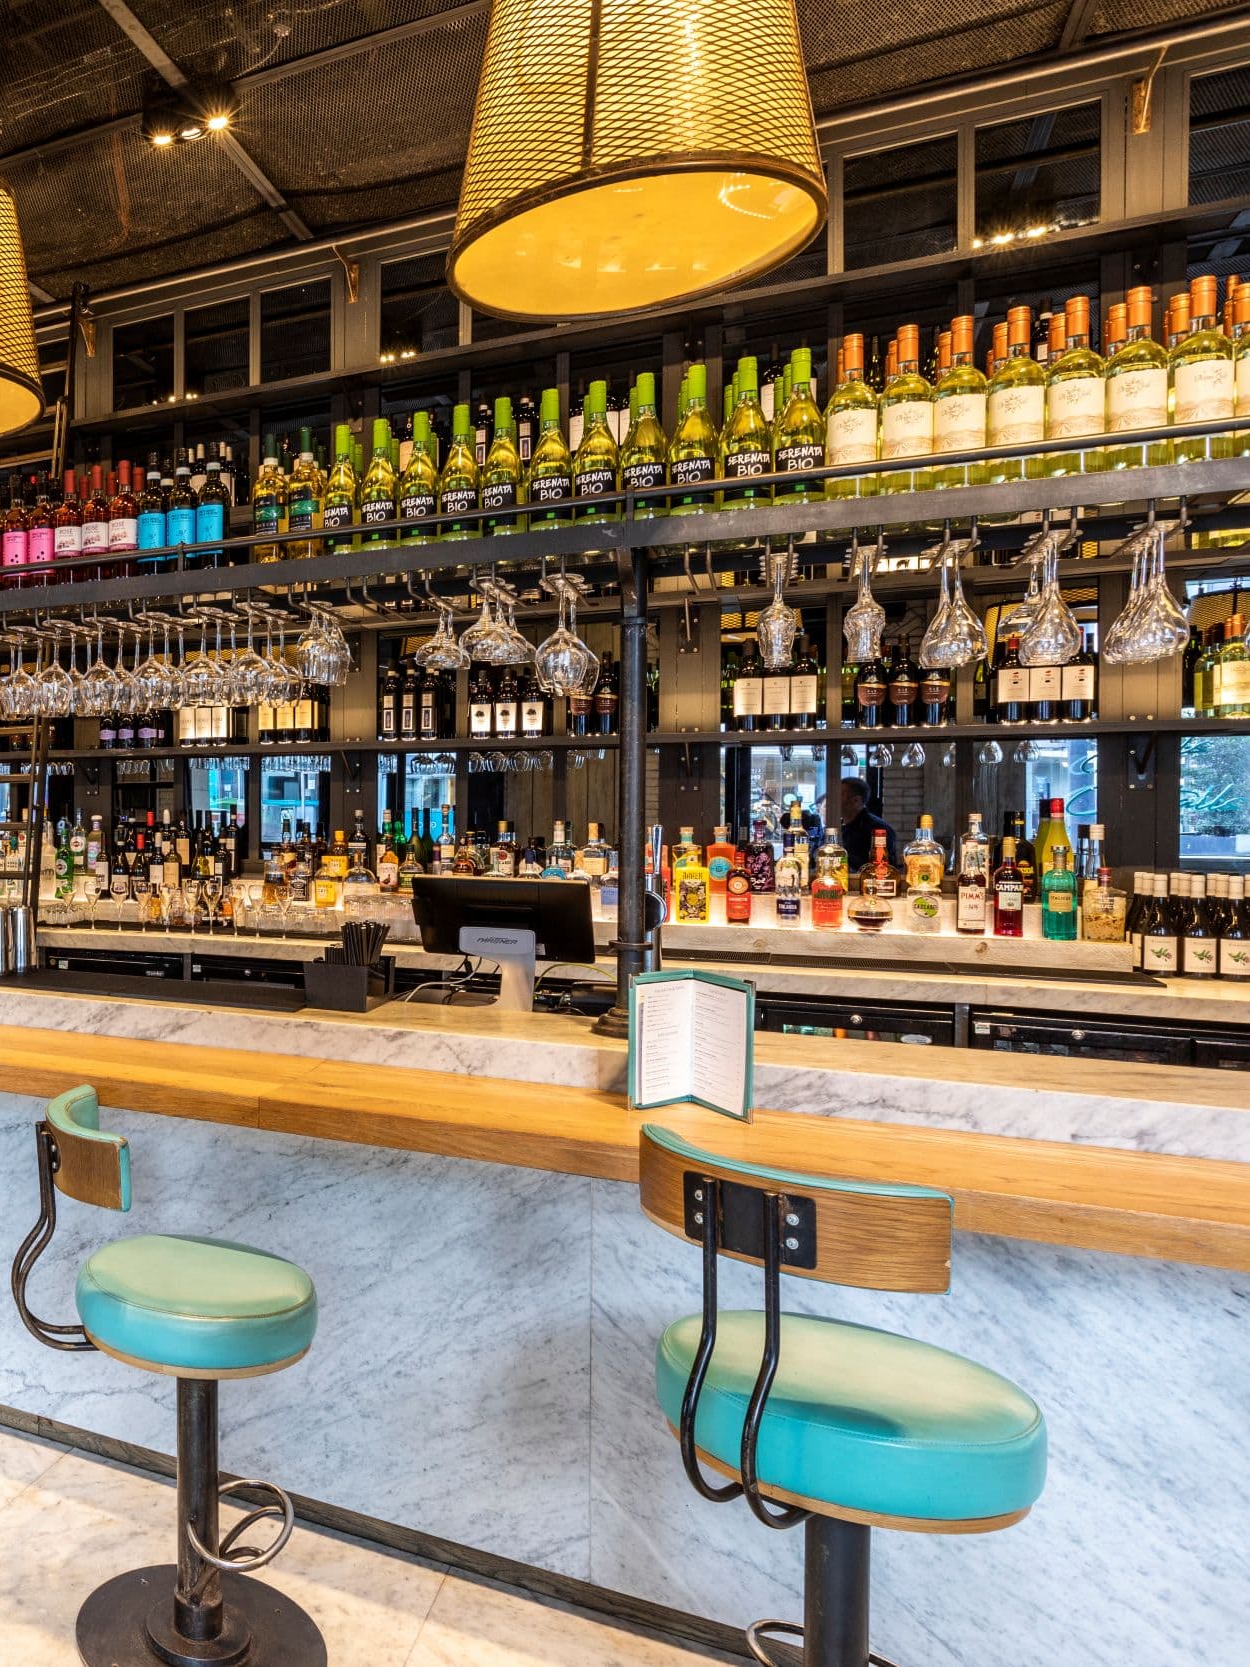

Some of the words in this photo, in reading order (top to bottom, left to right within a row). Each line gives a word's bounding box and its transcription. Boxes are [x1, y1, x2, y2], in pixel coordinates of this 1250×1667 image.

[727, 453, 771, 465] SERENATA
[778, 446, 823, 460] SERENATA
[624, 464, 663, 479] SERENATA
[671, 459, 711, 474] SERENATA
[737, 464, 763, 477] BIO
[788, 458, 814, 472] BIO
[532, 478, 570, 491] SERENATA
[576, 471, 613, 486] SERENATA
[631, 475, 654, 488] BIO
[677, 472, 701, 485] BIO
[540, 488, 563, 501] BIO
[581, 483, 603, 496] BIO
[447, 501, 468, 512] BIO
[484, 496, 503, 508] BIO
[366, 512, 386, 523] BIO
[406, 507, 426, 518] BIO
[324, 517, 340, 528] BIO
[961, 892, 985, 900] PIMM'S
